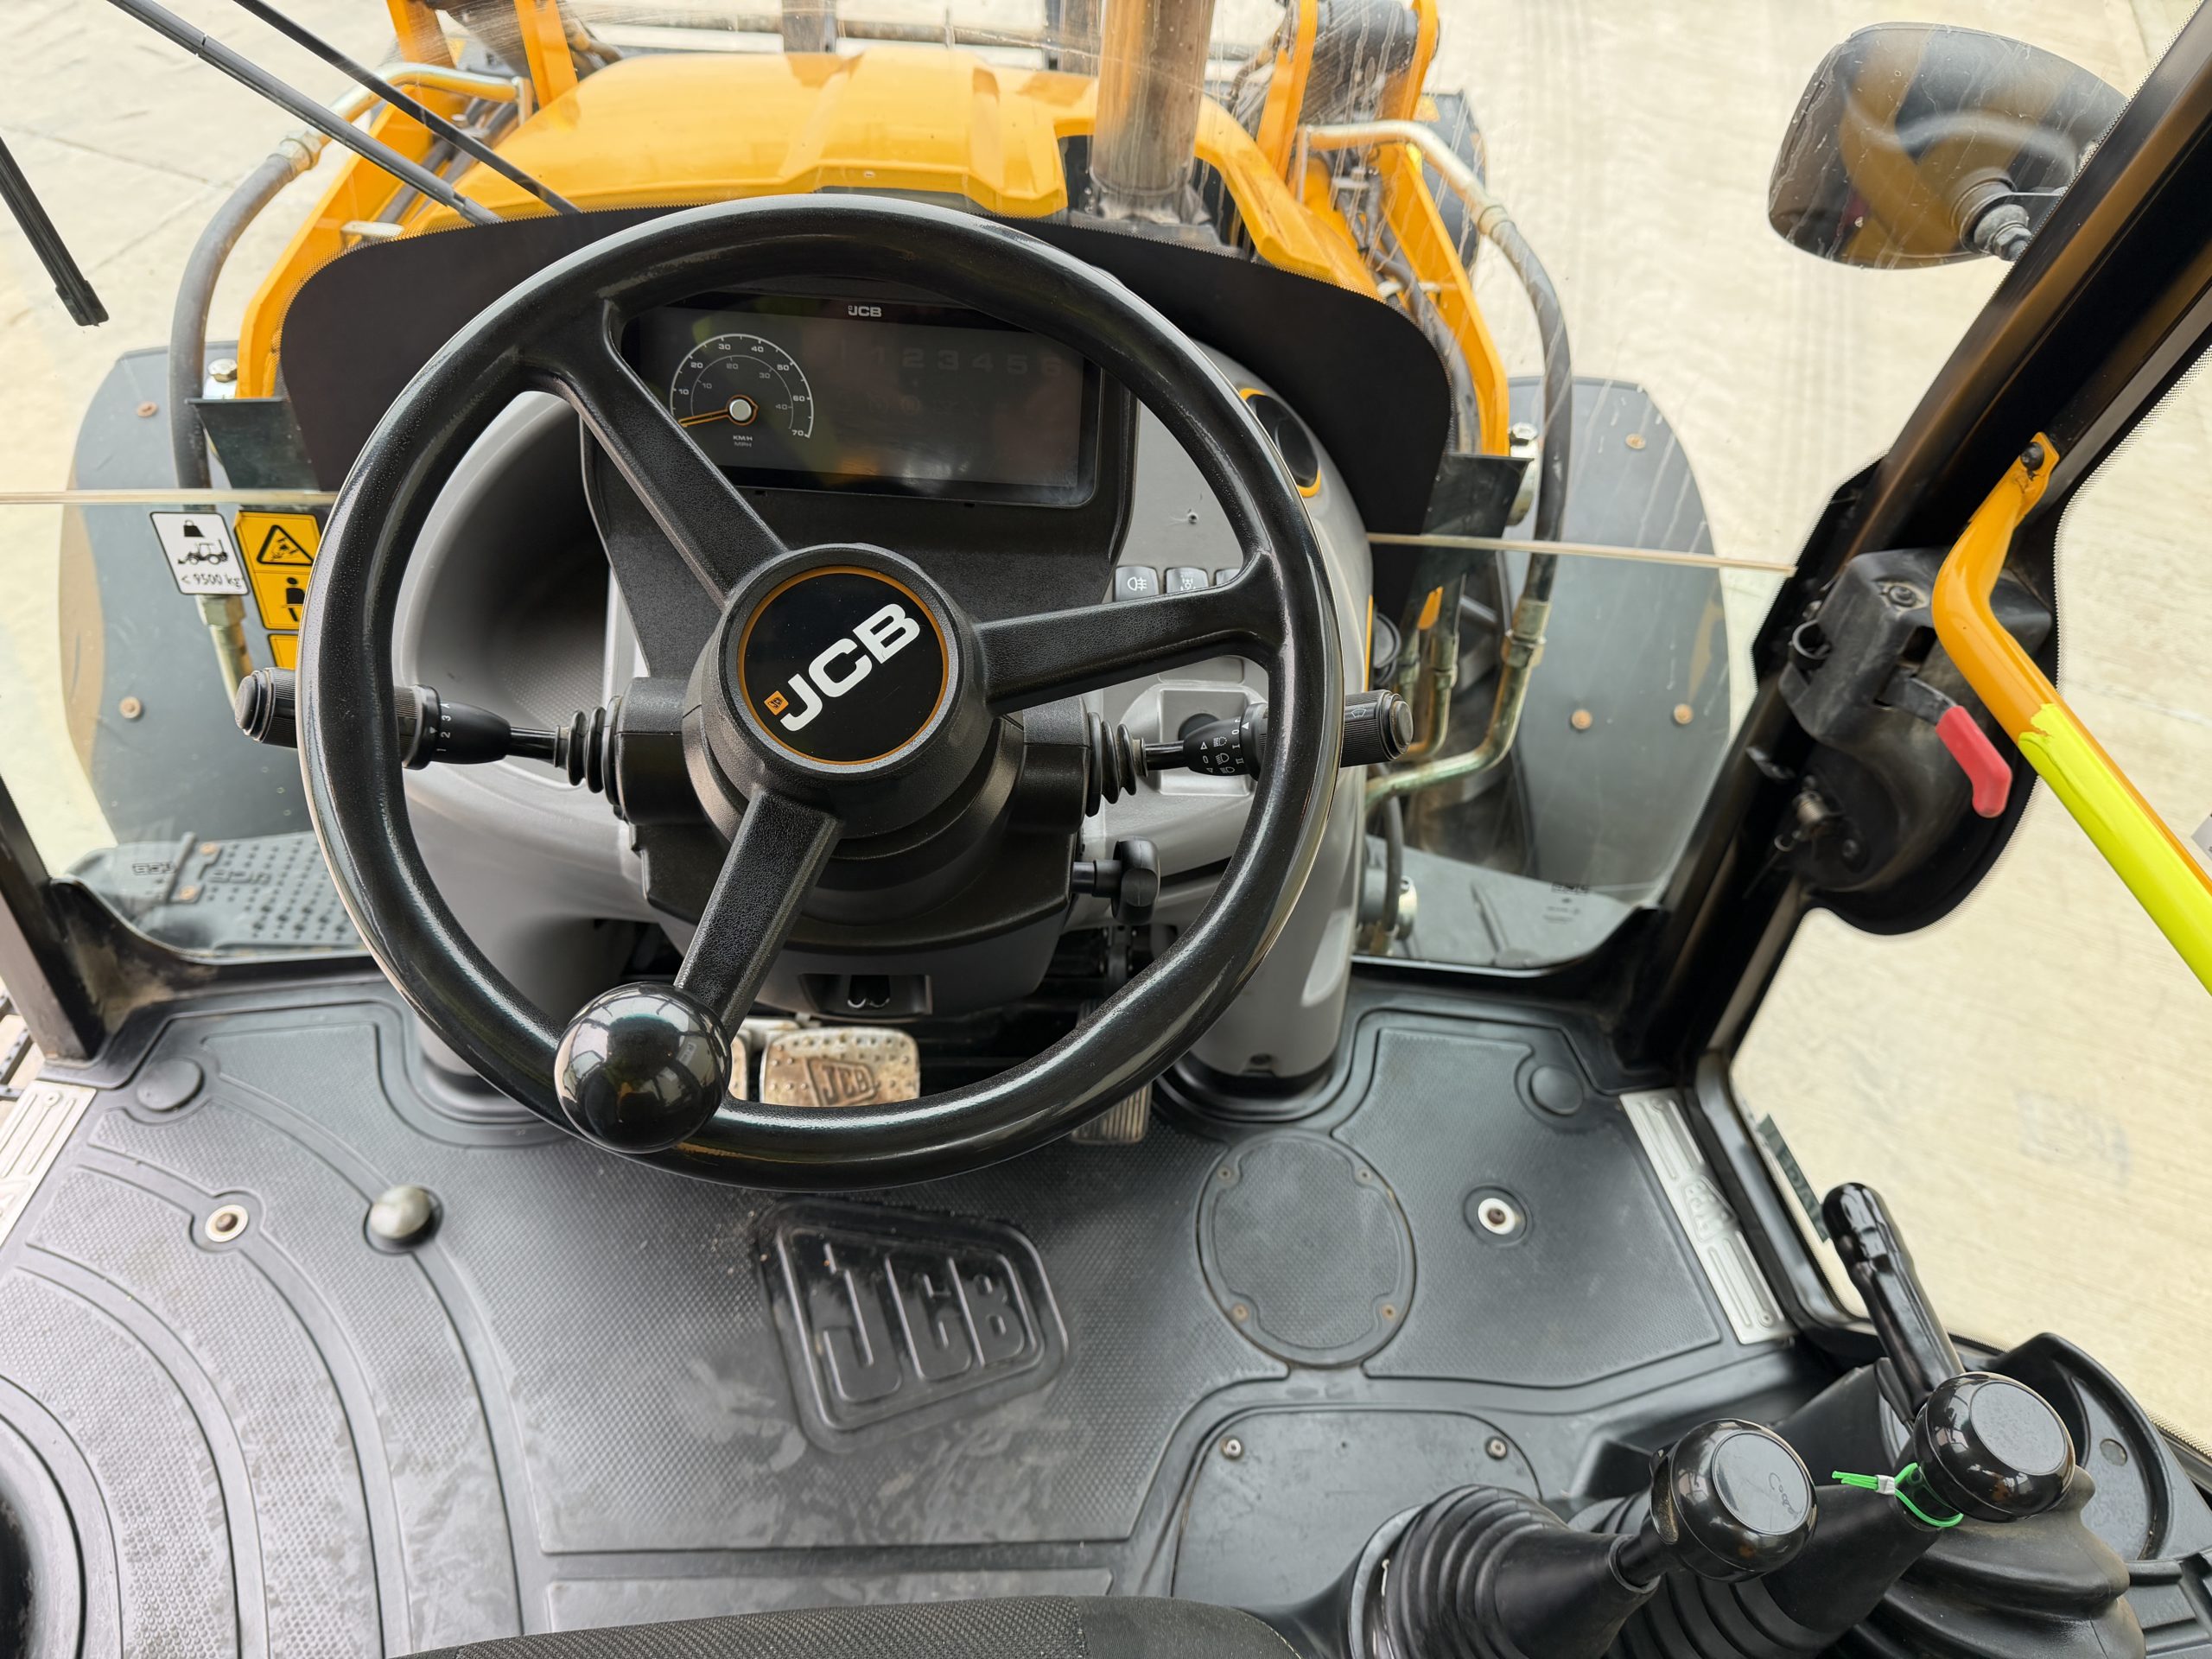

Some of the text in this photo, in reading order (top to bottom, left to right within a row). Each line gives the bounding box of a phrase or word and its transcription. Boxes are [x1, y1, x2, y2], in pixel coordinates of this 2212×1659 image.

[848, 305, 882, 317] JCB
[791, 429, 804, 437] 70
[193, 573, 223, 586] 9500
[779, 603, 920, 732] JCB
[821, 1064, 869, 1105] JCB
[808, 1240, 1026, 1403] JCB
